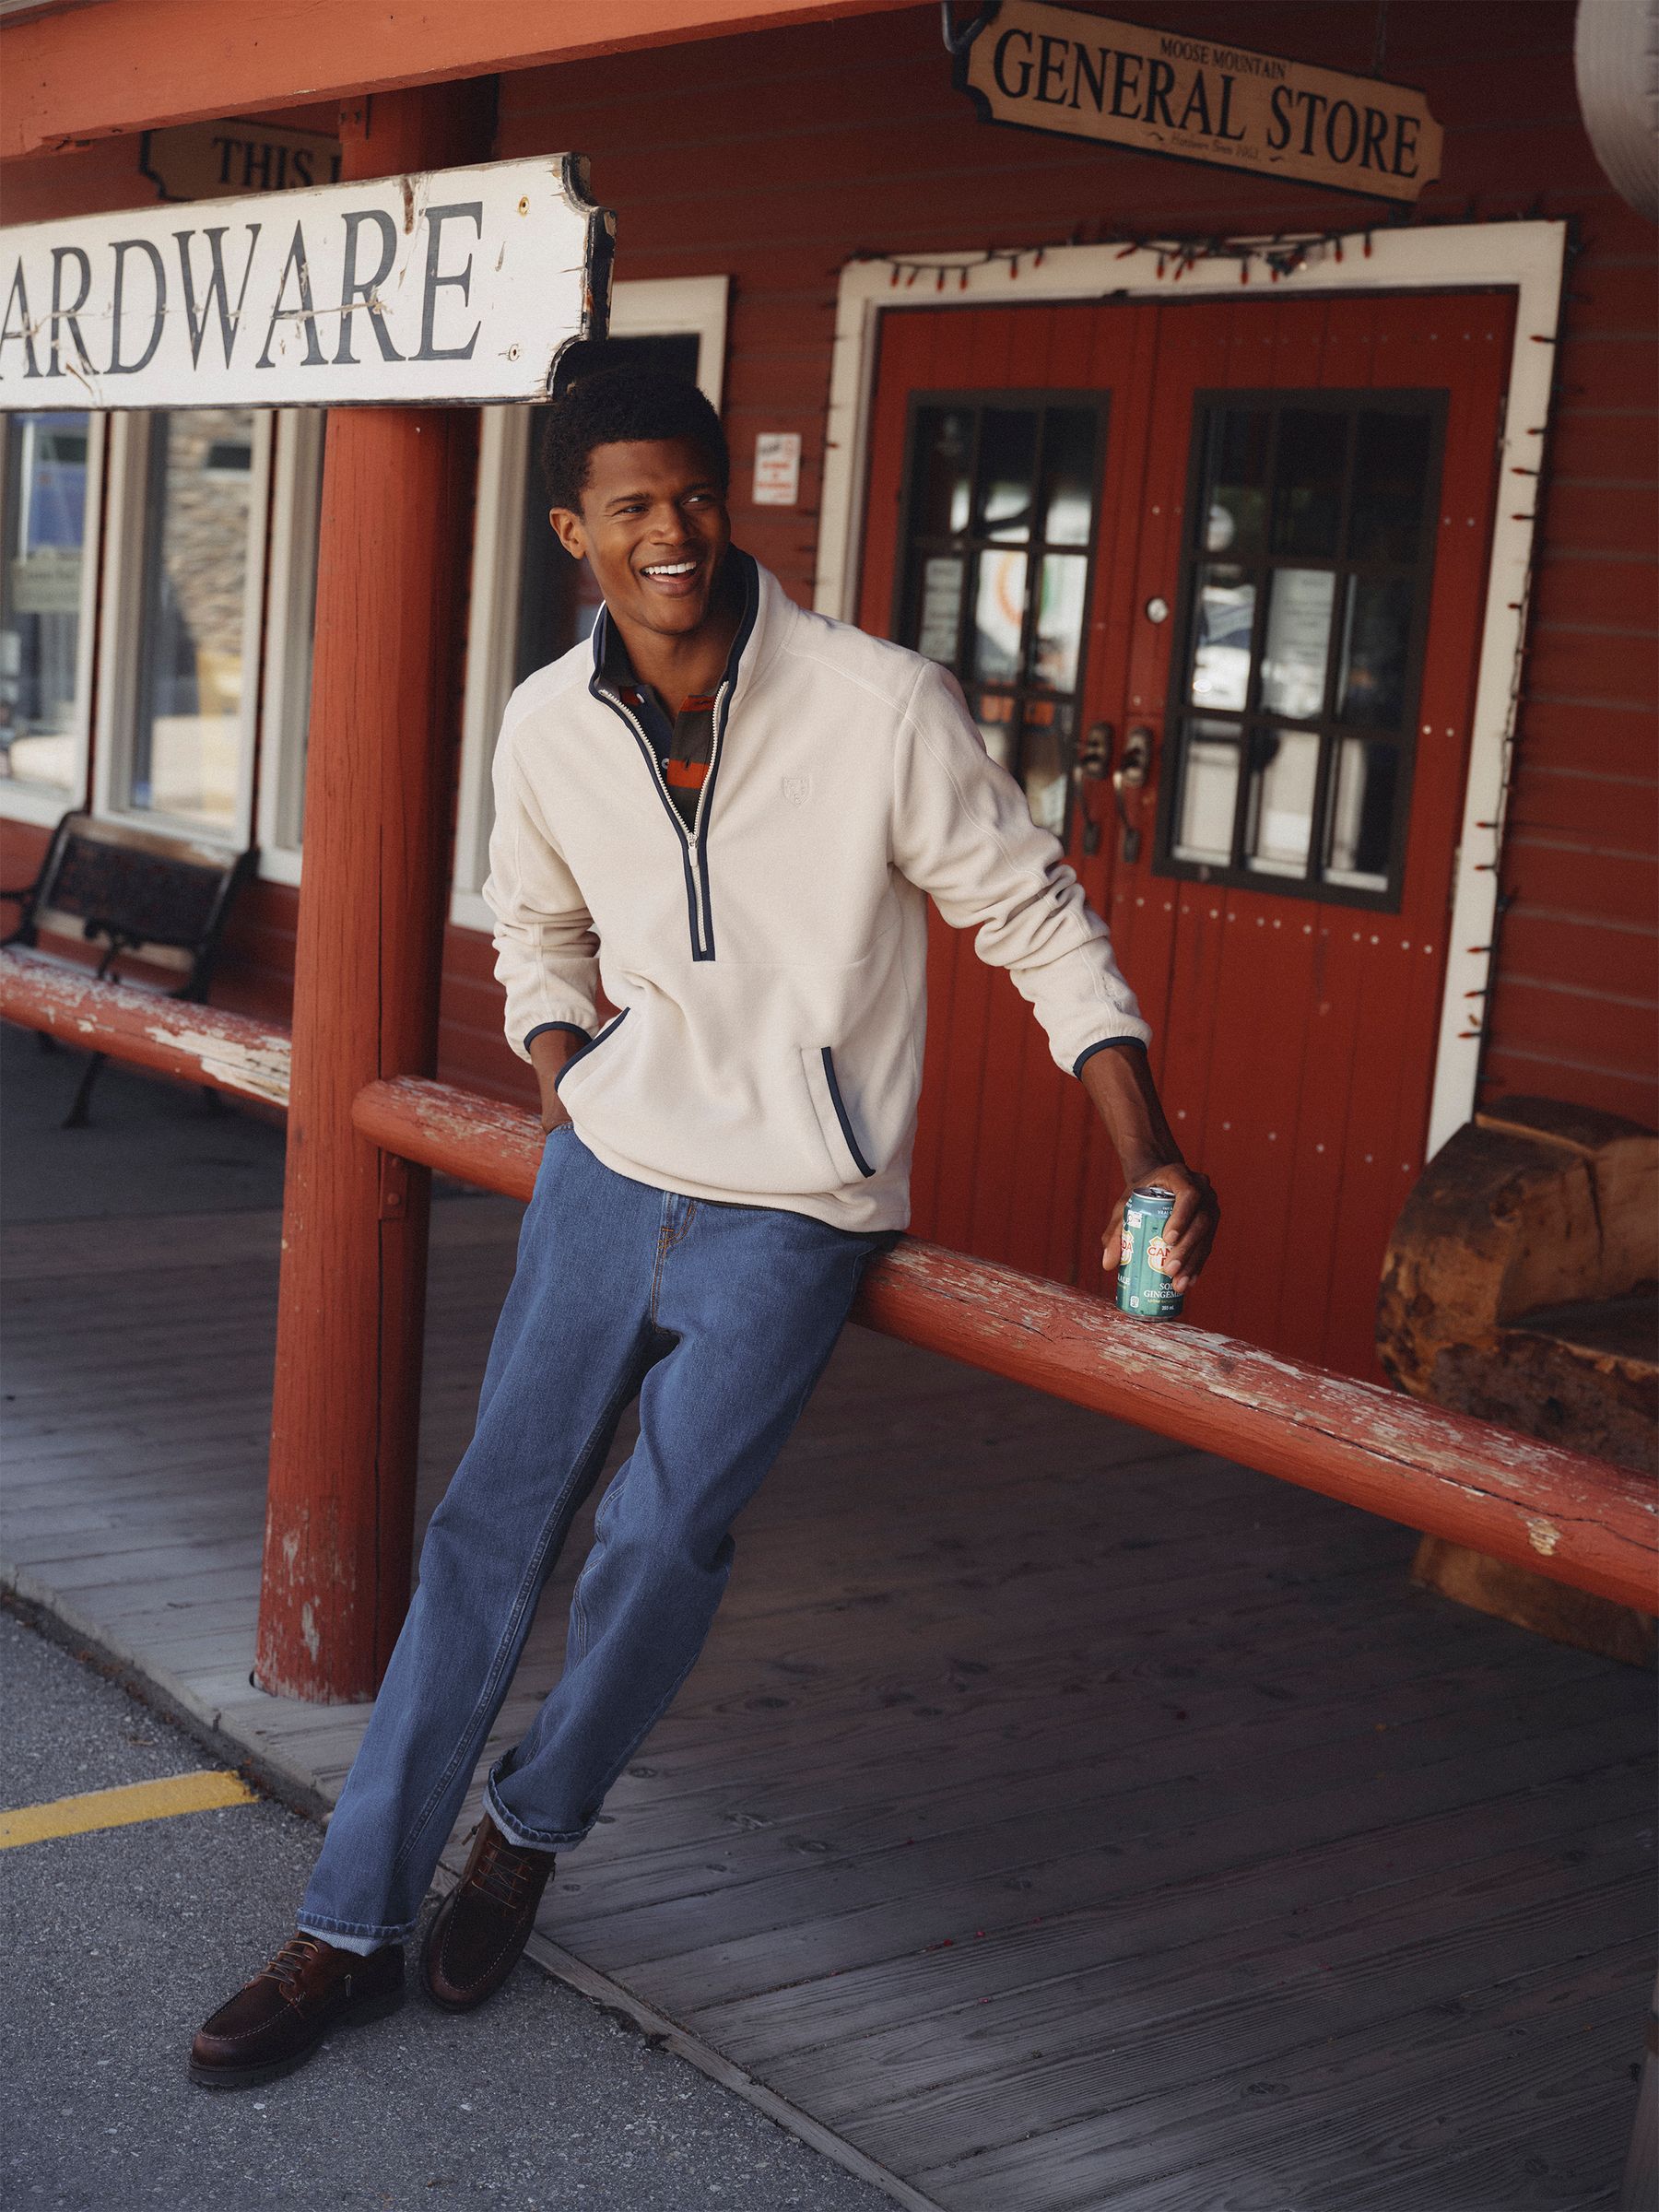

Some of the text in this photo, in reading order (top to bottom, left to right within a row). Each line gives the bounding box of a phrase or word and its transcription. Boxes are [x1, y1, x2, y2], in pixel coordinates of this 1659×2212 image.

[1161, 37, 1288, 79] MOOSE MOUNTAIN
[993, 28, 1421, 179] GENERAL STORE
[210, 136, 314, 190] THIS
[0, 201, 484, 380] ARDWARE
[1147, 1247, 1171, 1257] CAN
[1159, 1282, 1172, 1290] SO
